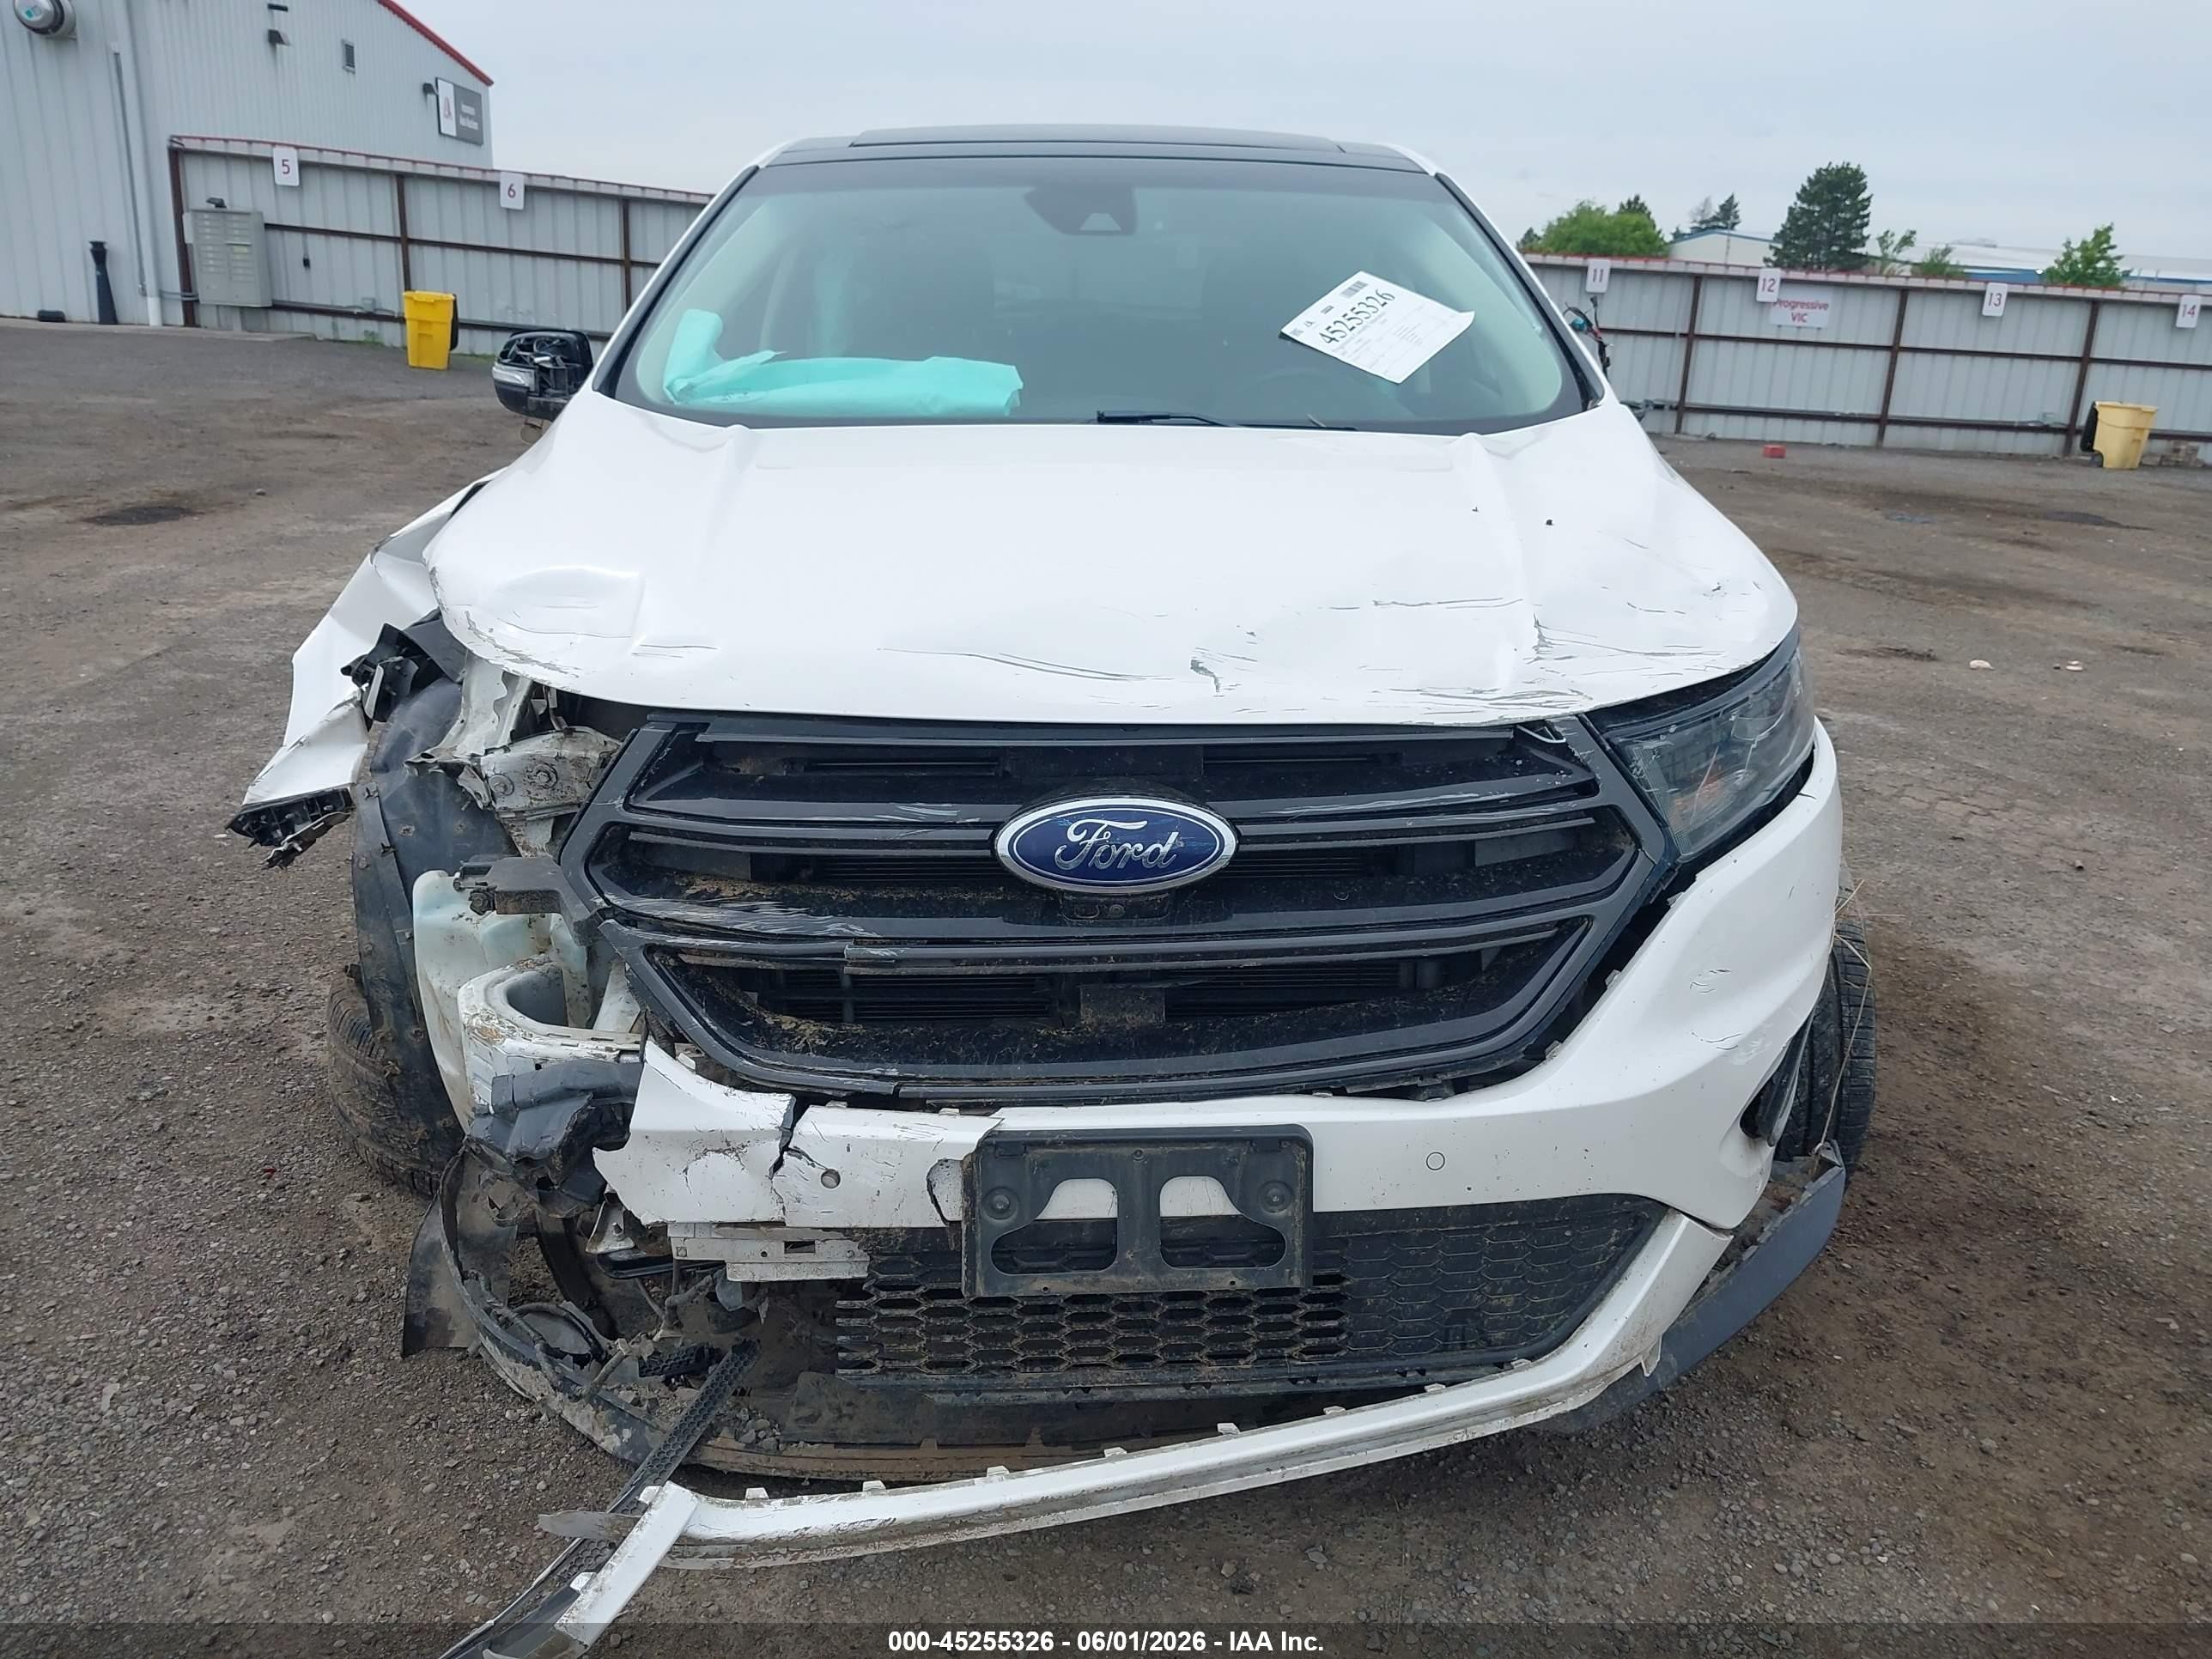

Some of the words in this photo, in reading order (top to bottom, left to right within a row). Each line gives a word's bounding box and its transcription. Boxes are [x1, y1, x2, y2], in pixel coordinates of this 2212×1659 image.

[281, 159, 290, 174] 5
[507, 183, 516, 198] 6
[1592, 268, 1604, 283] 11
[1760, 277, 1776, 293] 12
[1988, 292, 2002, 307] 13
[1318, 289, 1395, 344] 45255326
[1790, 312, 1808, 323] VIC
[2182, 304, 2197, 319] 14
[1054, 818, 1179, 871] Ford
